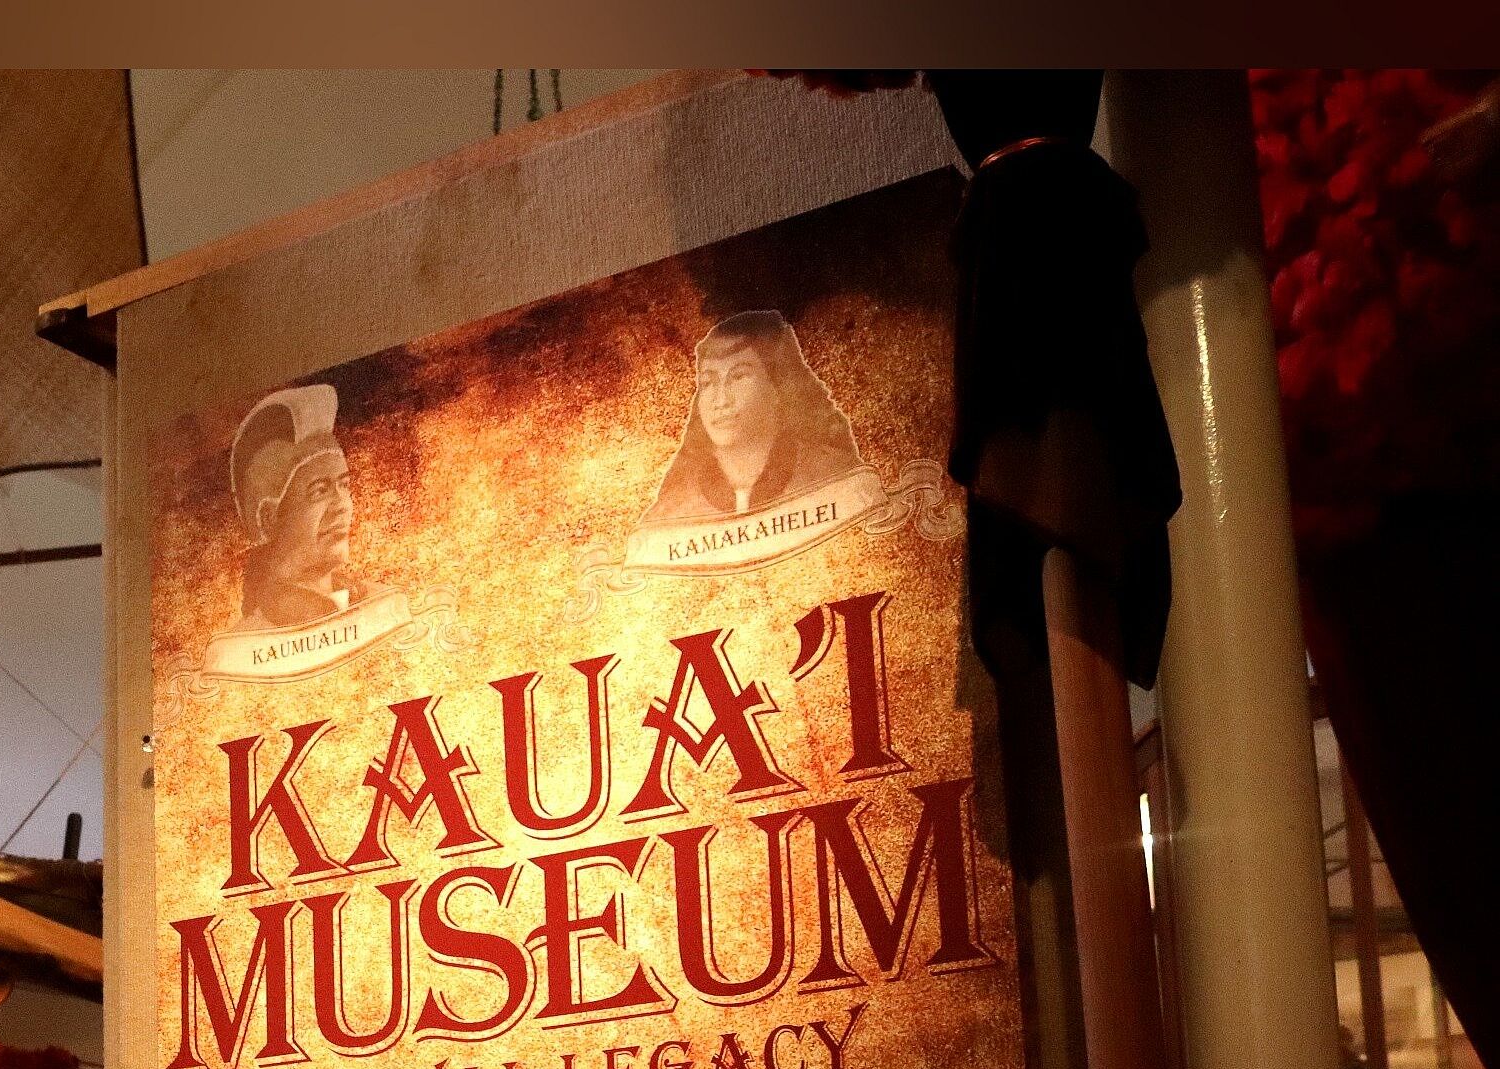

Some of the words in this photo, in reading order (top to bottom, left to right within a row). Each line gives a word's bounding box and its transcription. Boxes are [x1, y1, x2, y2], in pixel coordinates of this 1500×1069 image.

[668, 502, 838, 562] KAMAKAHELEI
[252, 624, 359, 665] KAUMUALI'I
[219, 590, 912, 898] KAUA'I
